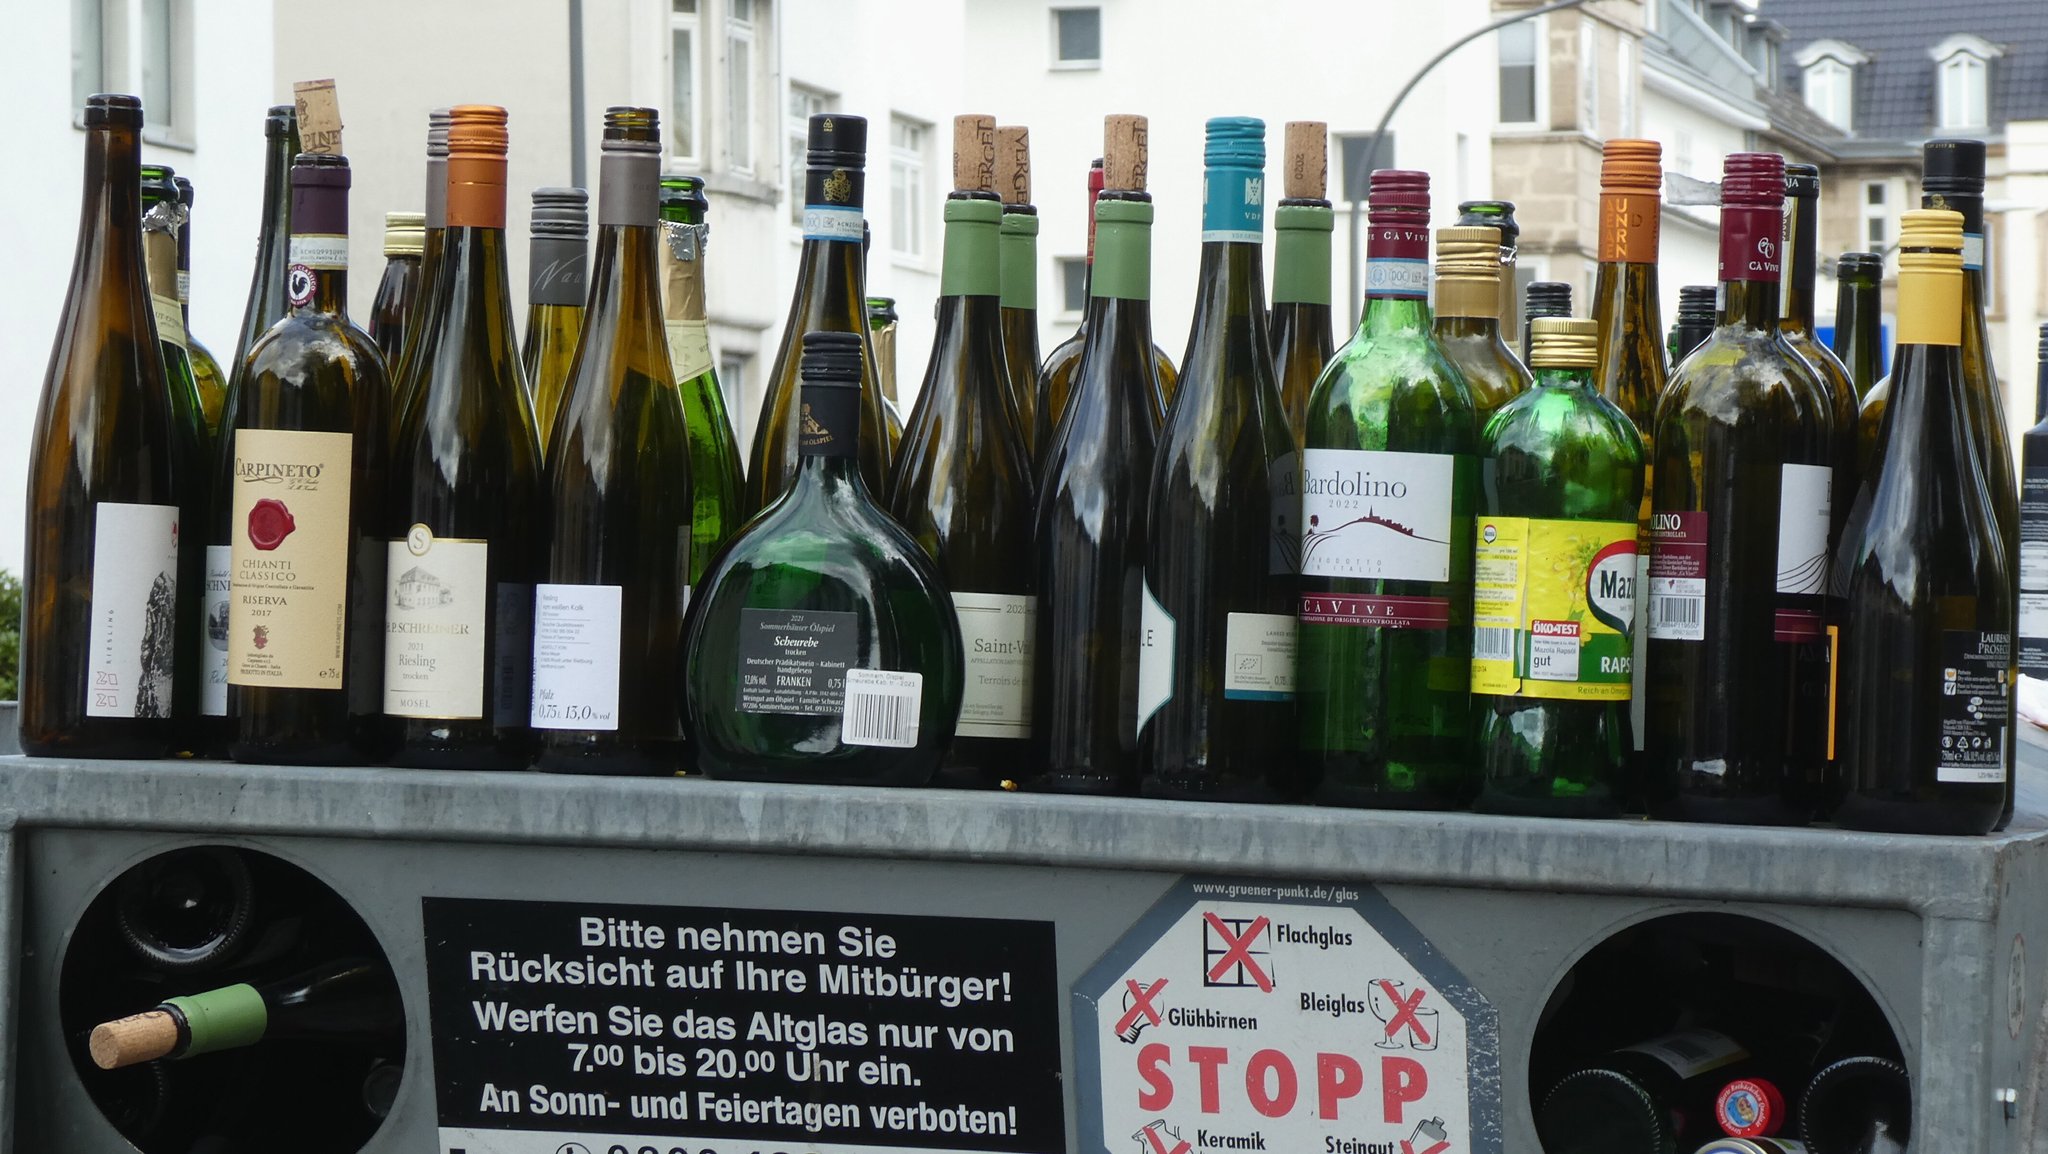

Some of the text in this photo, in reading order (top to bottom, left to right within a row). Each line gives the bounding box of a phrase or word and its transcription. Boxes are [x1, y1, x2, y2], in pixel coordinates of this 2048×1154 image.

[977, 119, 996, 191] ERGET
[1132, 121, 1148, 190] ERGET
[1012, 127, 1029, 204] VERGE
[1294, 153, 1305, 181] 2020
[1303, 469, 1408, 498] Bardolino
[1329, 499, 1359, 509] 2022
[413, 532, 424, 550] S
[242, 559, 292, 570] CHIANTI
[240, 570, 297, 582] CLASSICO
[242, 595, 288, 606] RISERVA
[1331, 600, 1395, 616] VIVE
[251, 609, 272, 617] 2017
[1362, 617, 1410, 627] CONTROLLATA
[106, 609, 115, 664] RIESLING
[774, 635, 819, 648] Scheurebe
[785, 648, 807, 656] trocken
[398, 653, 436, 672] Riesling
[746, 658, 775, 666] Deutscher
[820, 661, 845, 669] Kabinett
[1533, 655, 1552, 668] gut
[402, 671, 429, 681] trocken
[777, 666, 813, 675] handgelesen
[776, 675, 812, 687] FRANKEN
[827, 678, 842, 689] 0,75
[978, 674, 1011, 687] Terroirs
[539, 688, 555, 701] Pfalz
[1578, 686, 1600, 694] Reich
[1600, 687, 1610, 695] an
[399, 698, 431, 709] MOSEL
[538, 704, 557, 719] 0,75
[565, 704, 592, 720] 13,0
[599, 712, 611, 720] vol
[1192, 882, 1360, 904] www.gruener-punkt.de/glas
[580, 916, 897, 959] Bitte nehmen Sie
[1276, 923, 1354, 951] Flachglas
[470, 950, 1012, 1008] Rücksicht auf Ihre Mitbürger!
[1300, 991, 1365, 1019] Bleiglas
[471, 1000, 1015, 1053] Werfen Sie das Altglas nur von
[1167, 1007, 1259, 1031] Glühbirnen
[633, 1044, 687, 1076] bis
[785, 1050, 849, 1084] Uhr
[858, 1055, 922, 1087] ein.
[1136, 1041, 1430, 1125] STOPP
[479, 1082, 1018, 1136] An Sonn- und Feiertagen verboten!
[1197, 1129, 1267, 1151] Keramik
[1325, 1135, 1395, 1154] Steingut
